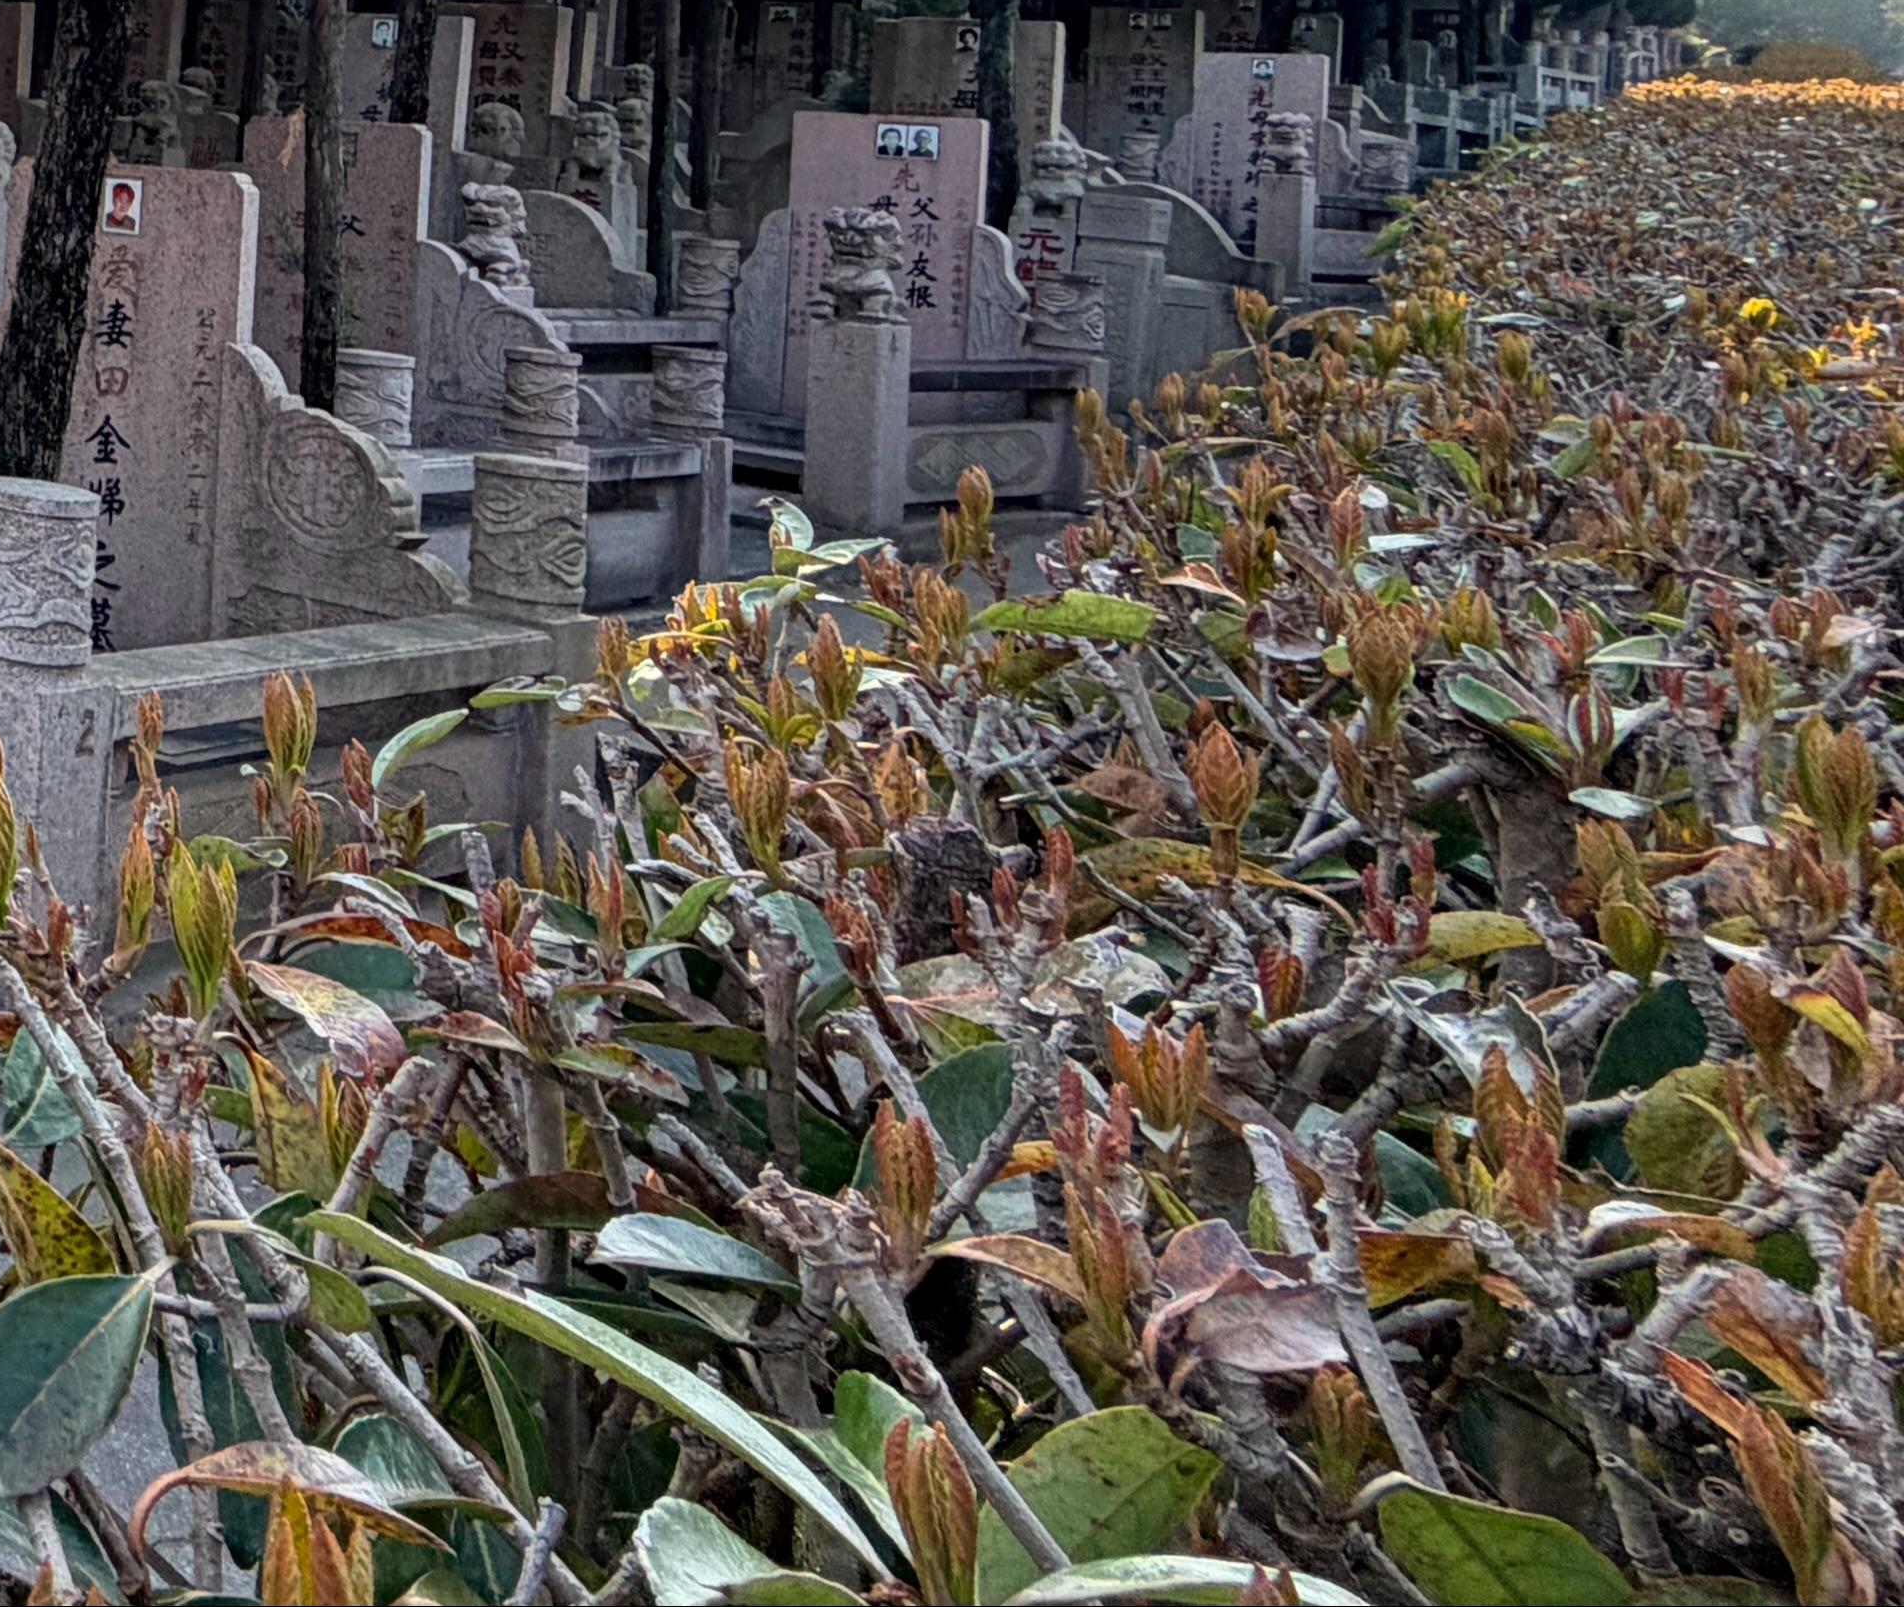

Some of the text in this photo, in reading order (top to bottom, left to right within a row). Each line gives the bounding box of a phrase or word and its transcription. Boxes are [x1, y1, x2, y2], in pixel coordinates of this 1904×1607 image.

[892, 163, 920, 192] 先
[906, 198, 940, 309] 父孙友根
